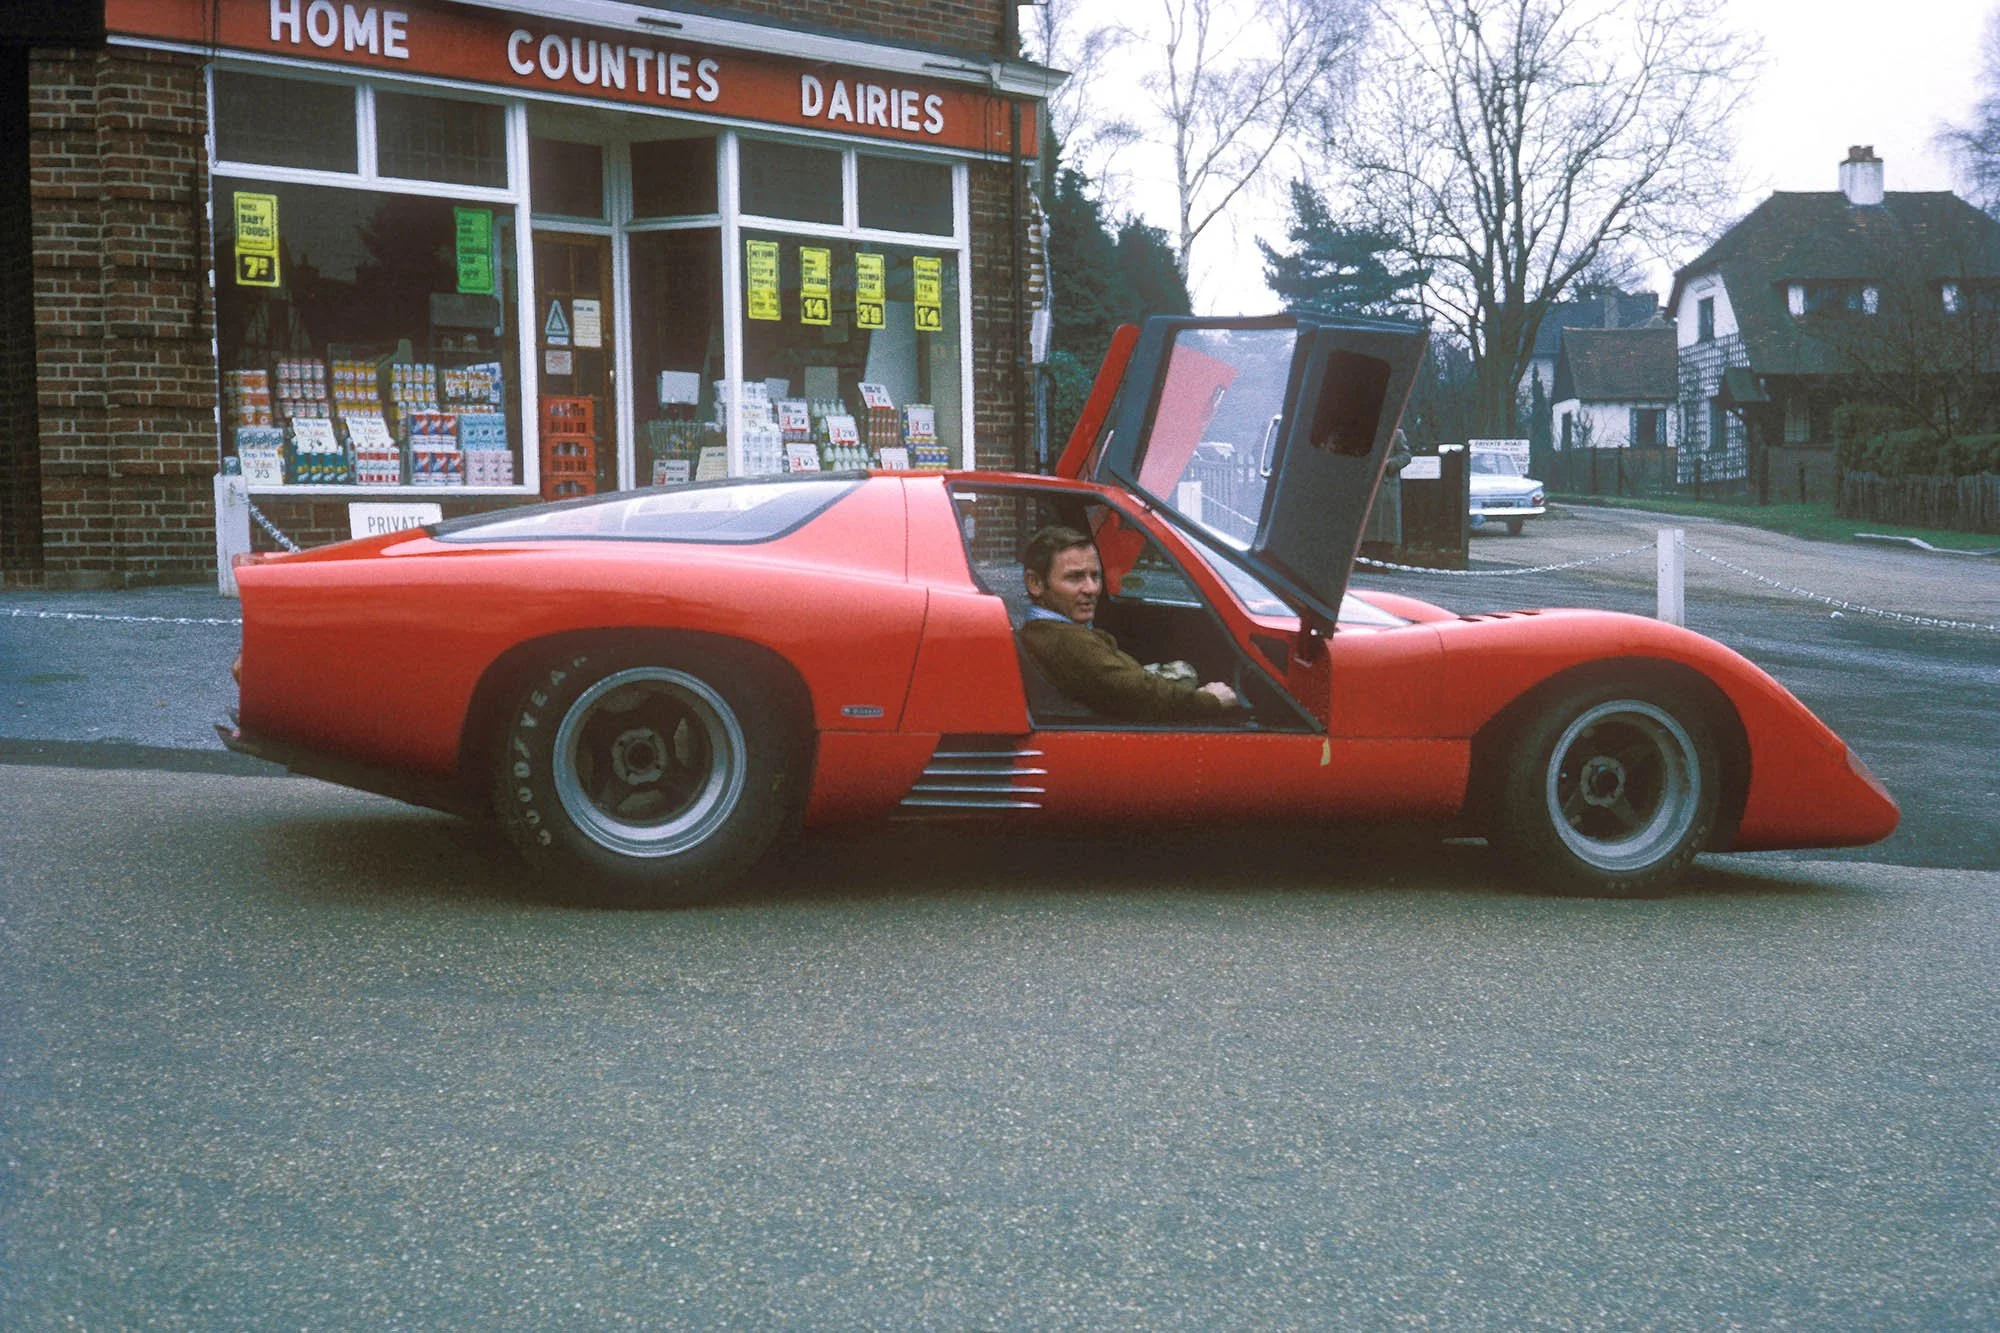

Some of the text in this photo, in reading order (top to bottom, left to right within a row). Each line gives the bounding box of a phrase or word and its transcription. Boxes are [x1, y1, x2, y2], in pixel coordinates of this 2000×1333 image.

[270, 0, 945, 135] HOME COUNTIES DAIRIES
[240, 214, 265, 226] BABY
[367, 515, 424, 535] PRIVATE
